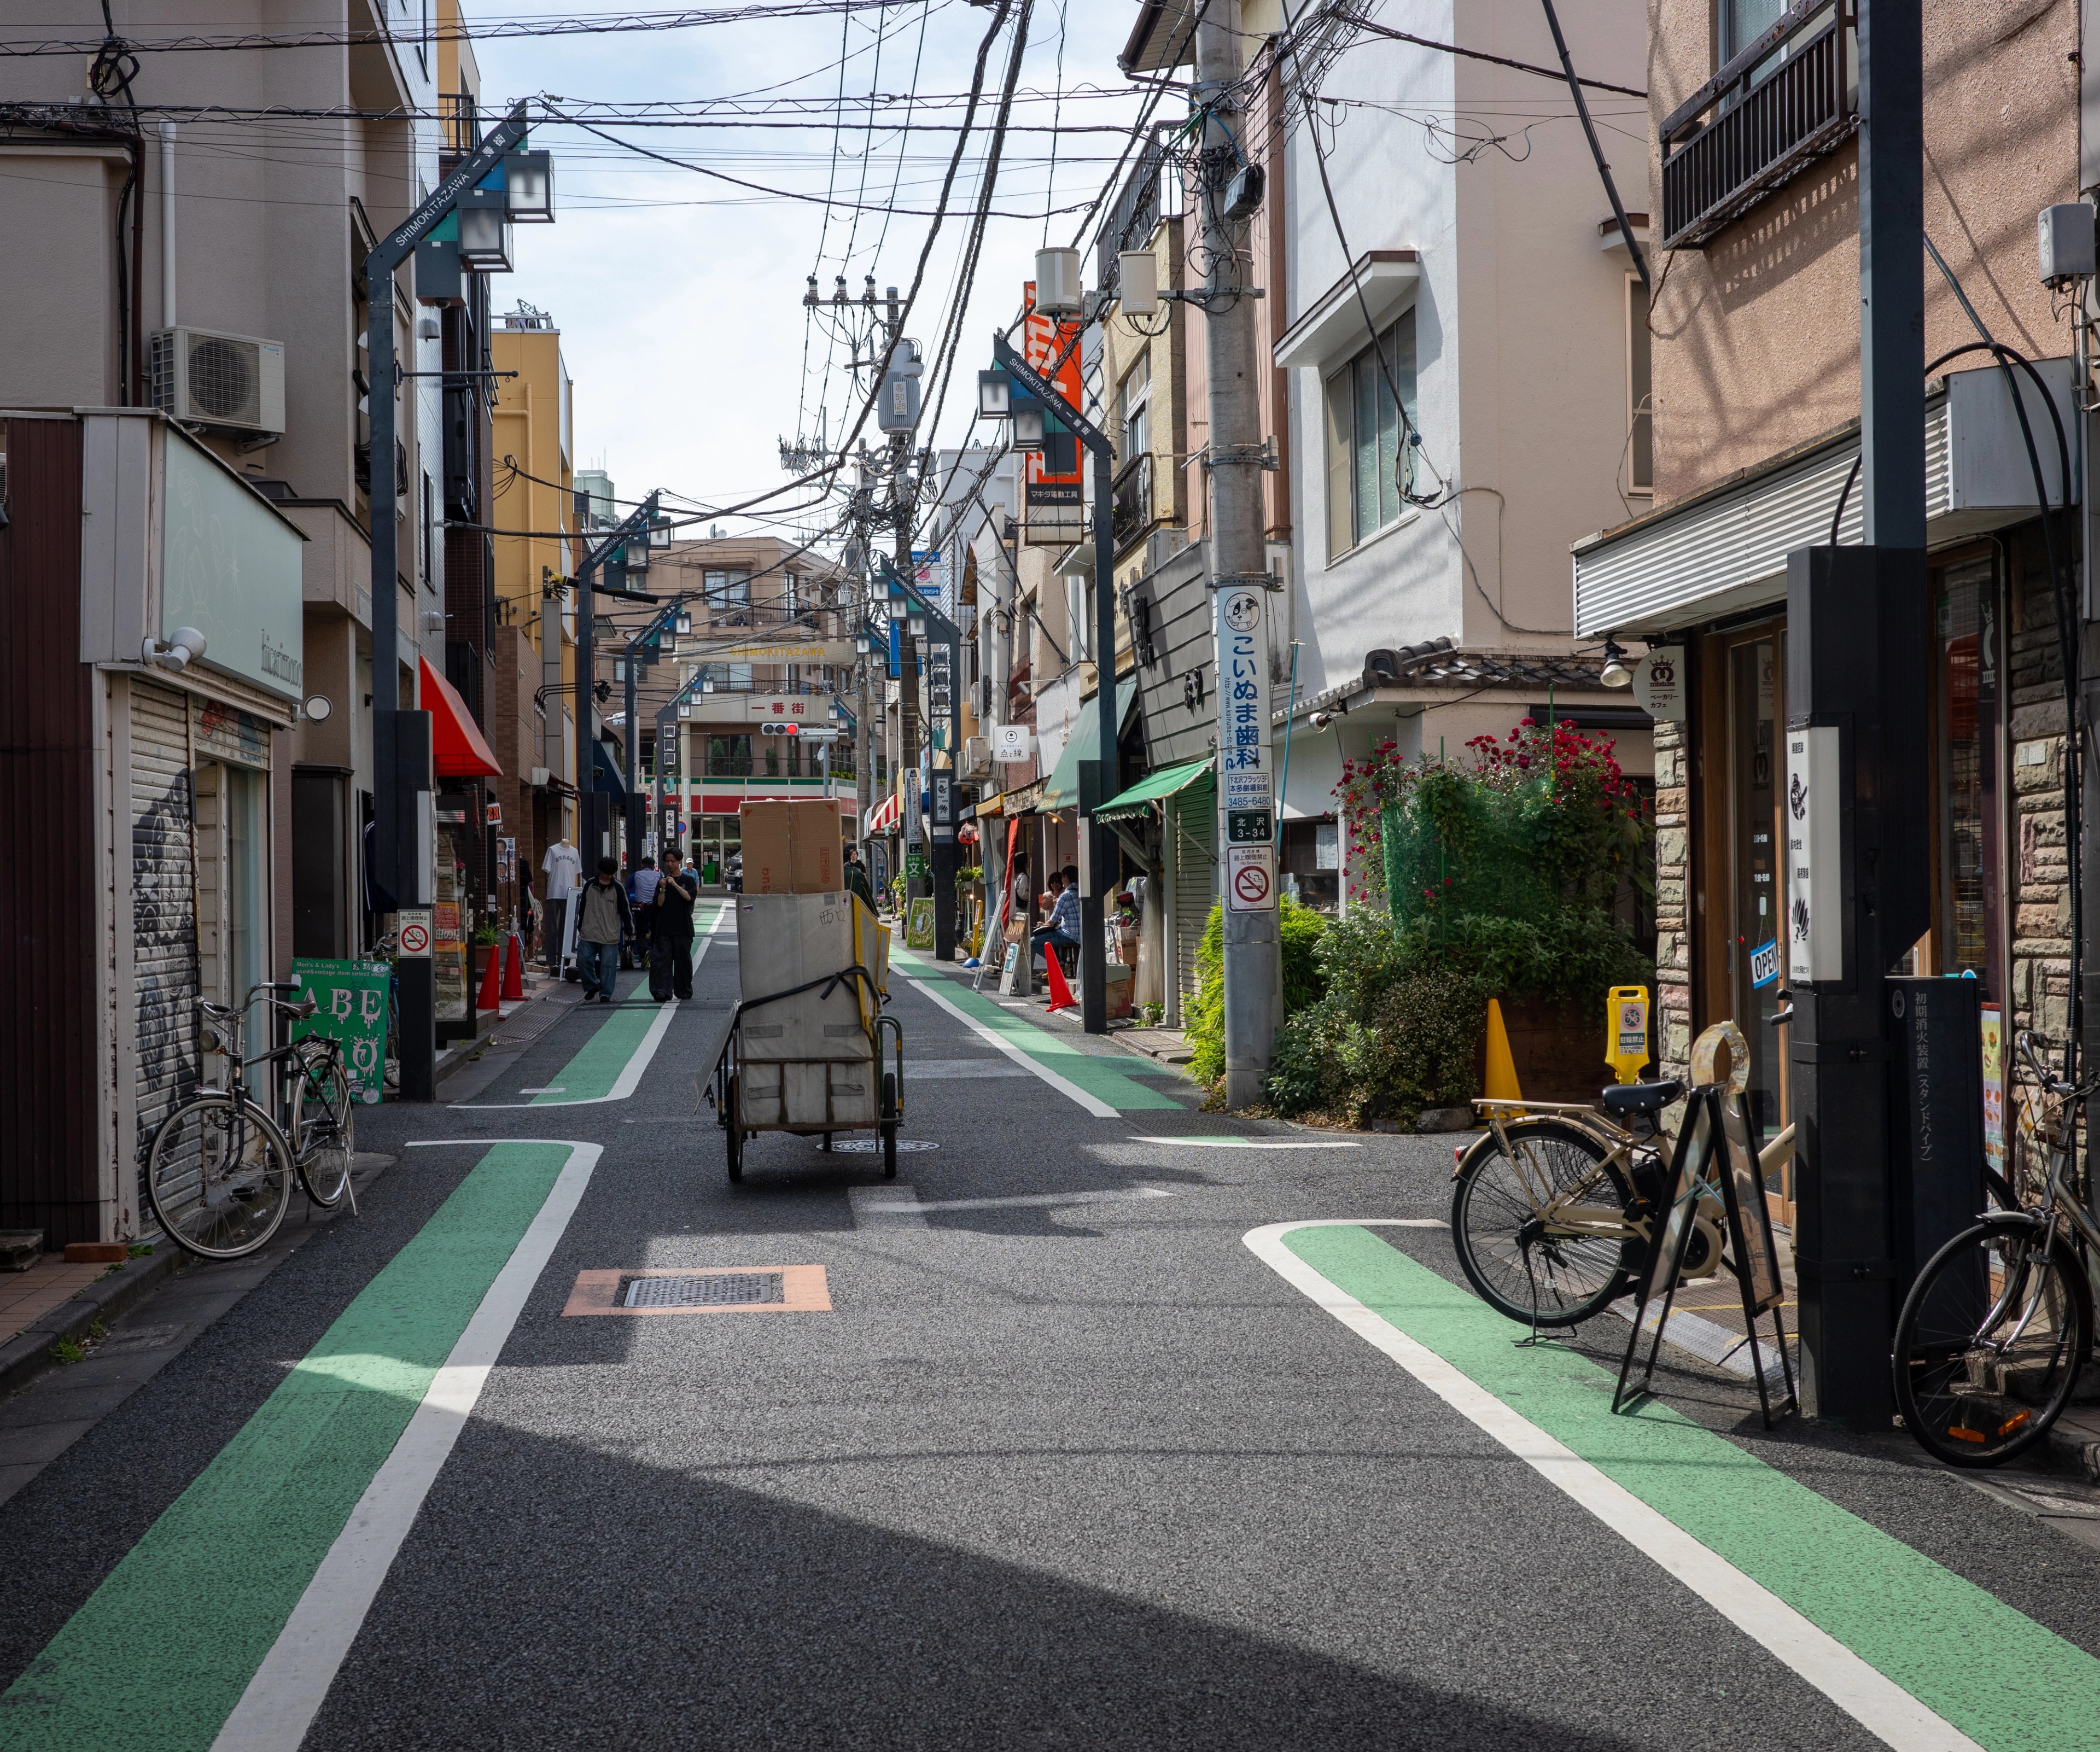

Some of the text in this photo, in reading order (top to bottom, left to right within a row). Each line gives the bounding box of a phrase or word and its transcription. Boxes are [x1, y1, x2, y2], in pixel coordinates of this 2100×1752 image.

[395, 133, 506, 246] SHIMOKITAZAWA 一番街
[1009, 358, 1091, 436] SHIMOKITAZAWA 一番街
[895, 575, 926, 606] SHIMOKITAZAWA
[634, 618, 663, 646] SHIMOKITAZAWA
[730, 647, 826, 657] SHIMOKITAZAWA
[751, 702, 805, 715] 一番街
[1233, 636, 1261, 769] こいぬま歯科
[1229, 775, 1268, 784] 下北沢フラッツ3F
[1230, 784, 1268, 792] 本多劇場斜前
[1228, 796, 1270, 807] 3485-6480
[1237, 817, 1265, 827] 北沢
[1238, 828, 1265, 838] 3-34
[1009, 926, 1022, 936] OPEN
[1755, 945, 1777, 980] OPEN
